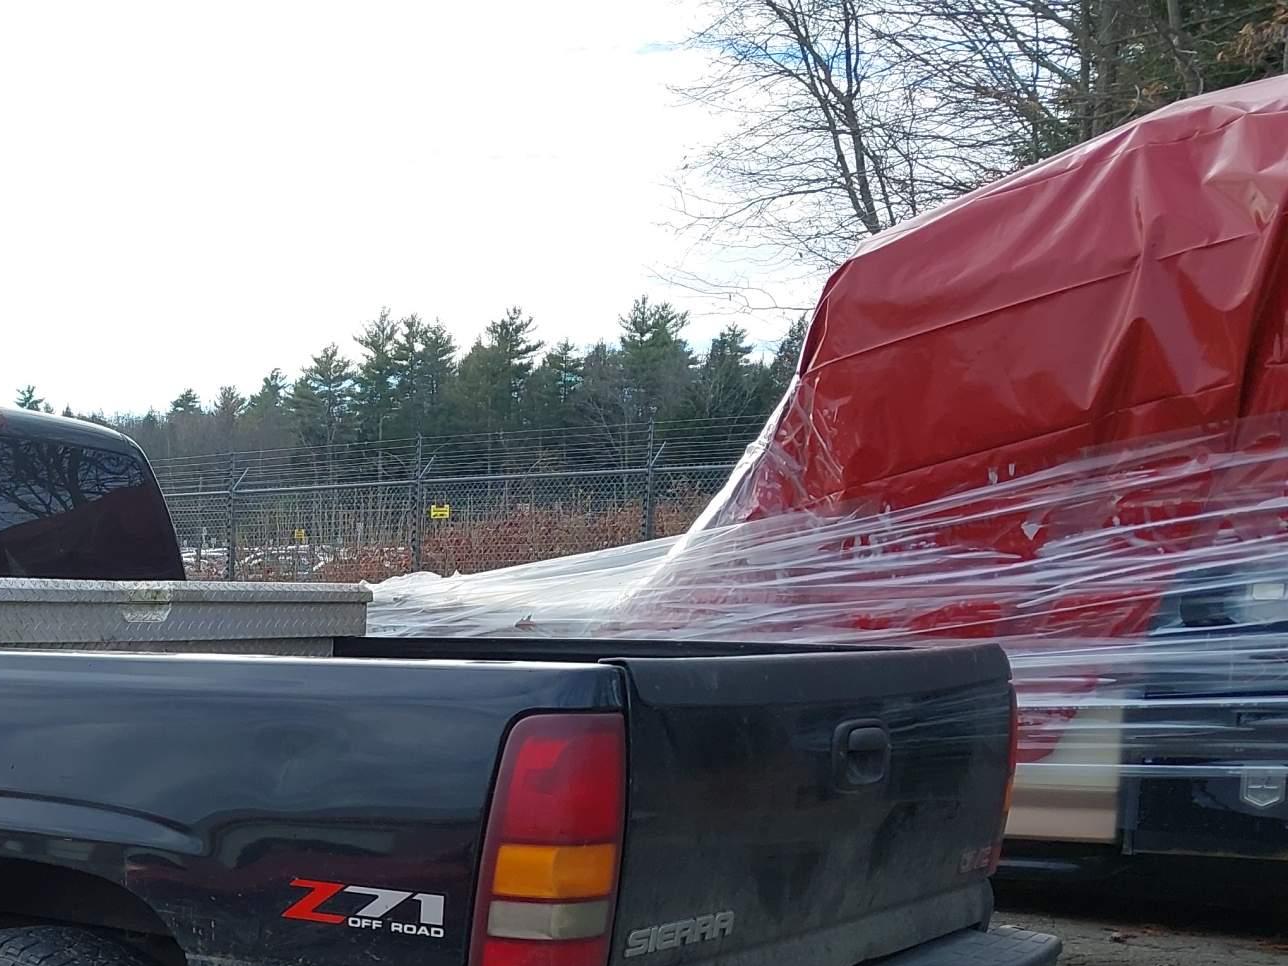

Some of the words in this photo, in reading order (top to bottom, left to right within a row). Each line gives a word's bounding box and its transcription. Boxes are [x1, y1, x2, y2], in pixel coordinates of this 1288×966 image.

[281, 878, 445, 927] Z71
[347, 916, 383, 930] OFF
[390, 922, 445, 938] ROAD
[623, 909, 735, 958] SIERRA
